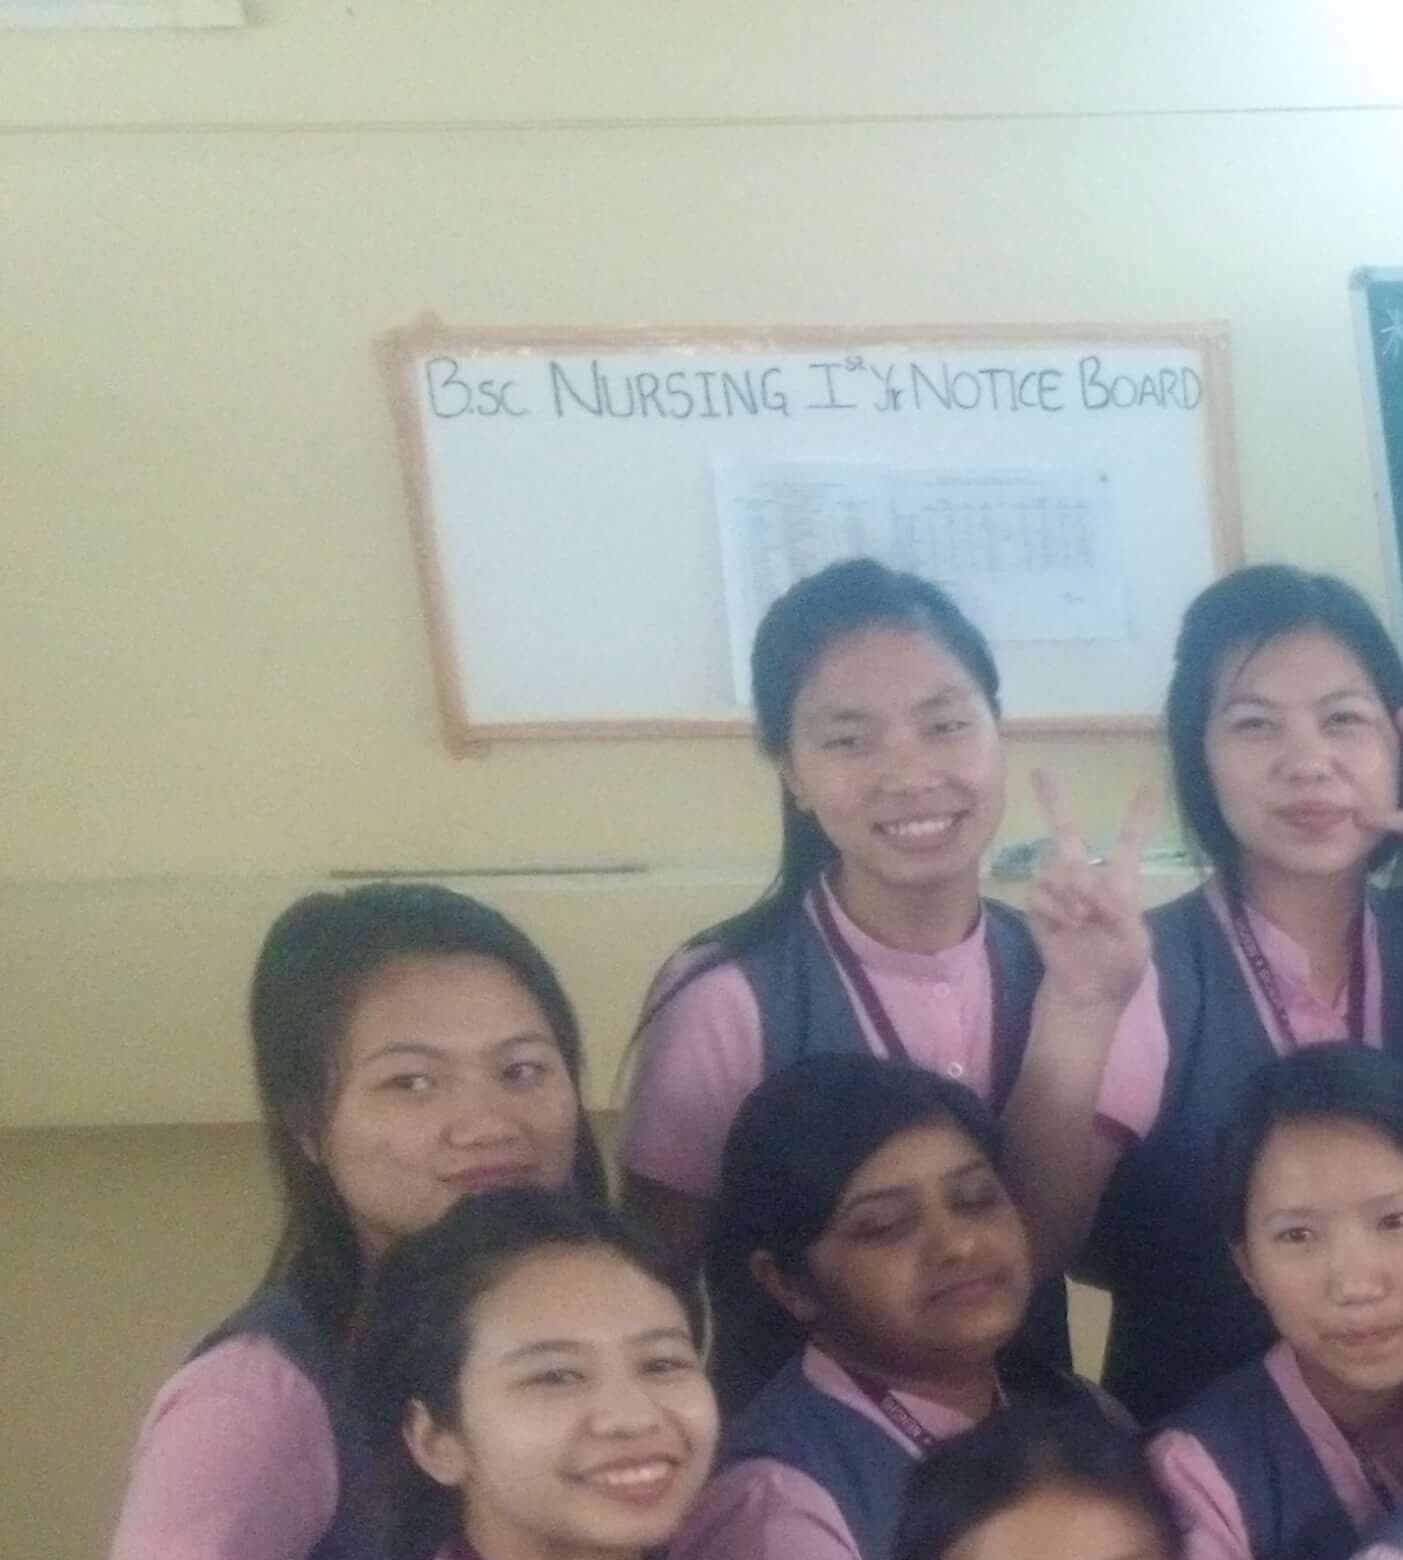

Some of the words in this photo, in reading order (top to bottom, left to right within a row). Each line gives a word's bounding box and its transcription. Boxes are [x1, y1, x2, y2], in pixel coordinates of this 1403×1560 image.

[548, 359, 791, 419] NURSING
[910, 360, 1065, 413] NOTICE
[1079, 355, 1201, 410] BOARD
